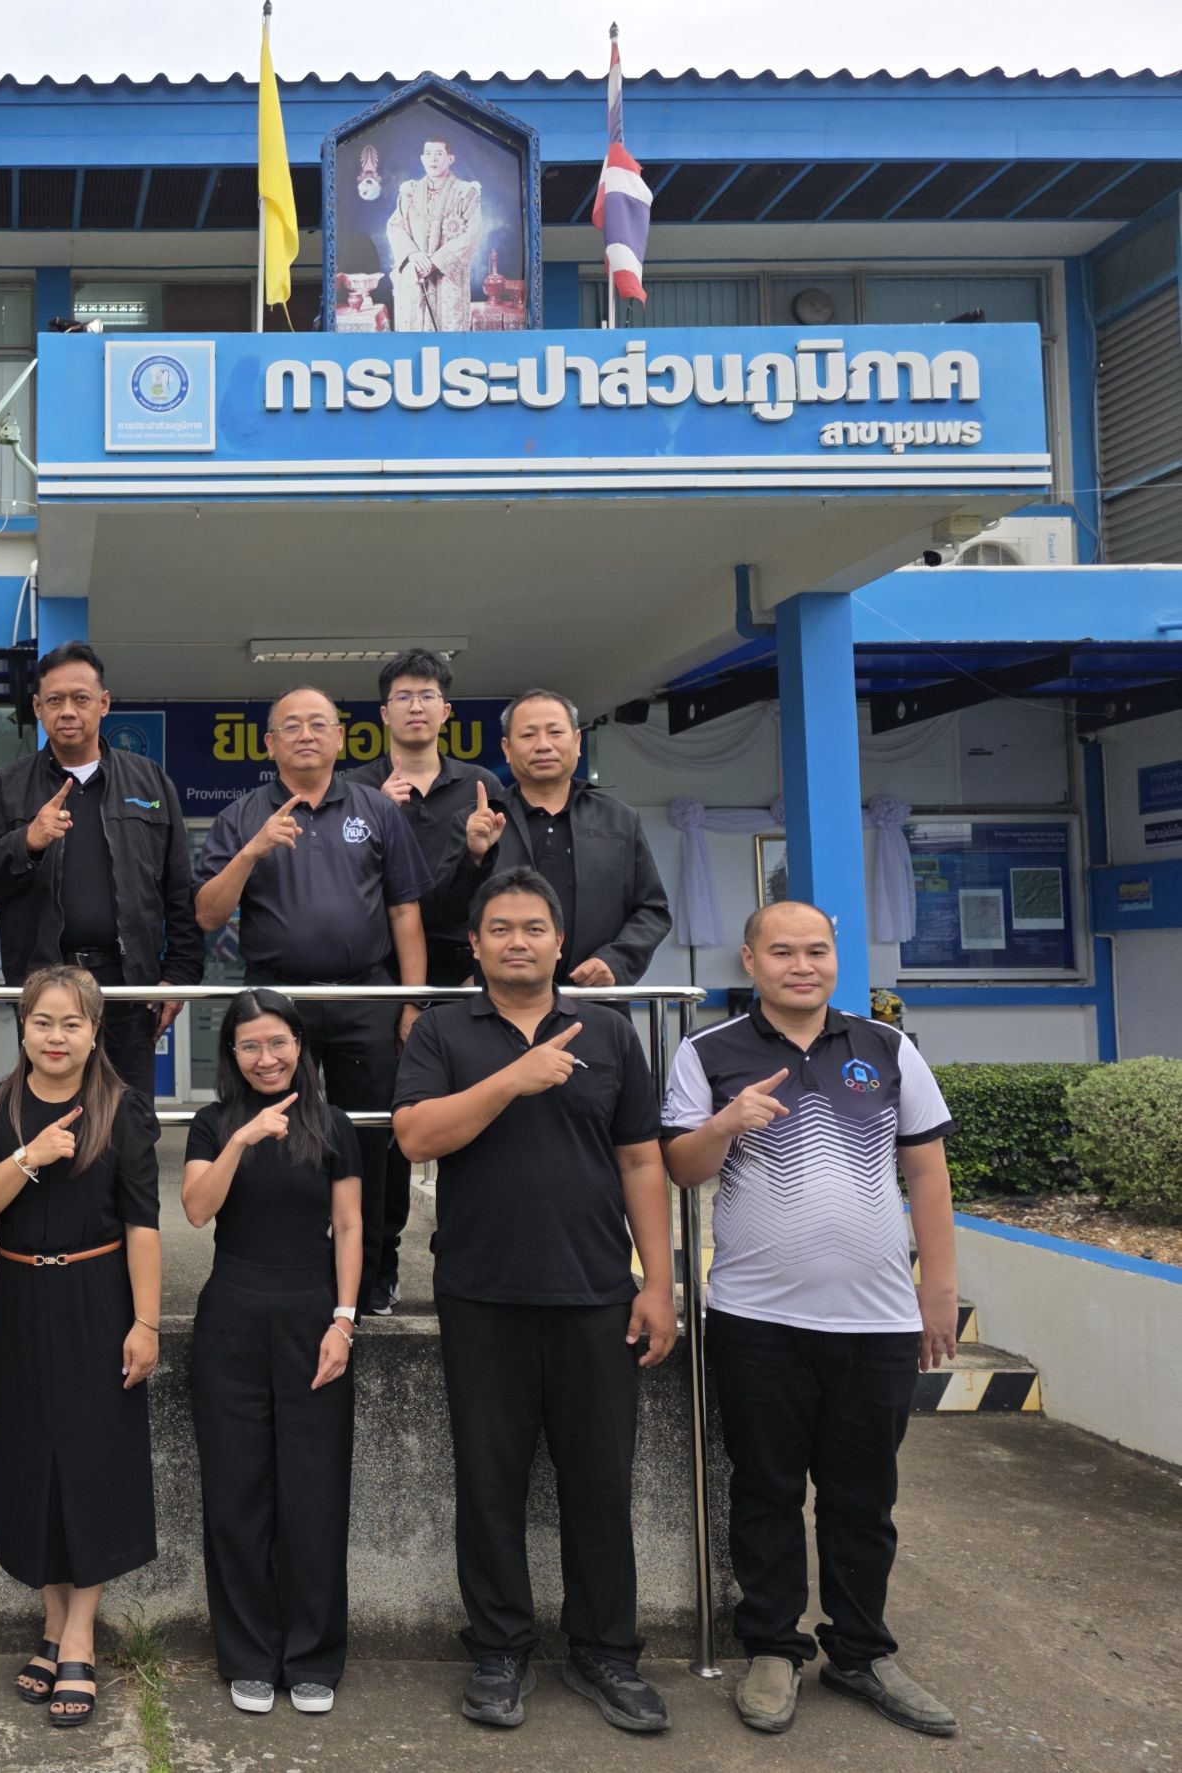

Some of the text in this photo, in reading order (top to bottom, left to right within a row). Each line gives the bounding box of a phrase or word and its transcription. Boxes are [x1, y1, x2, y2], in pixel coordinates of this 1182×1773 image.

[265, 338, 981, 422] การประปาส่วนภูมิภาค
[820, 420, 982, 454] สาขาชุมพร
[186, 787, 247, 800] Provincial
